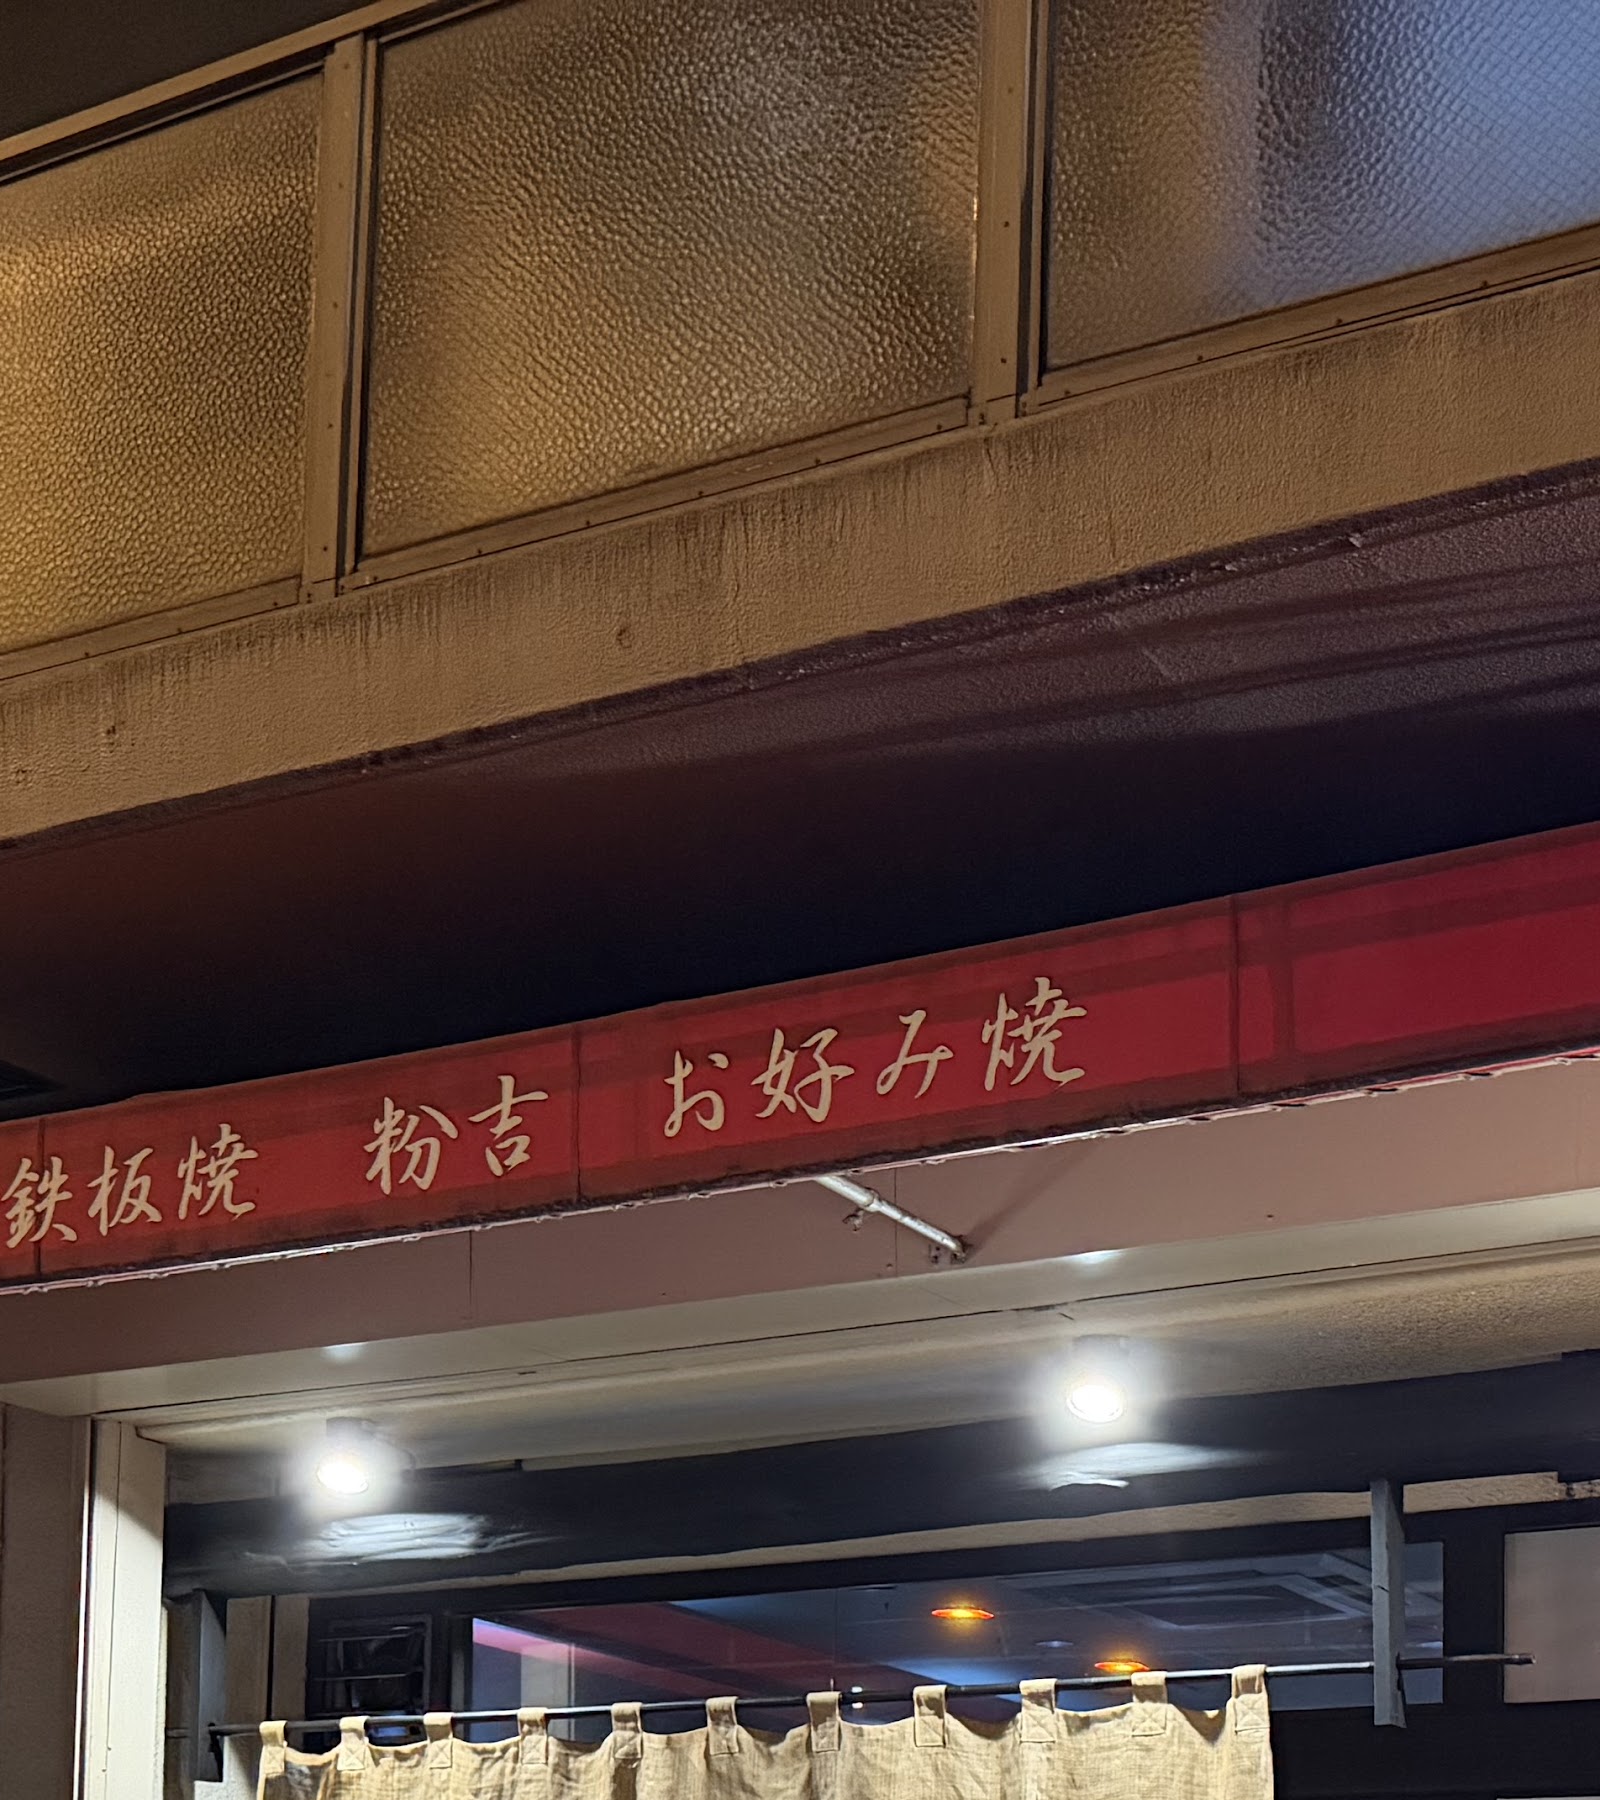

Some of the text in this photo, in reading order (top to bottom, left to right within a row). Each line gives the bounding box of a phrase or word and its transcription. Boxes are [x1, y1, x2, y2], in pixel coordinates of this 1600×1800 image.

[0, 975, 1088, 1250] 鉄板焼 粉吉 お好み焼
